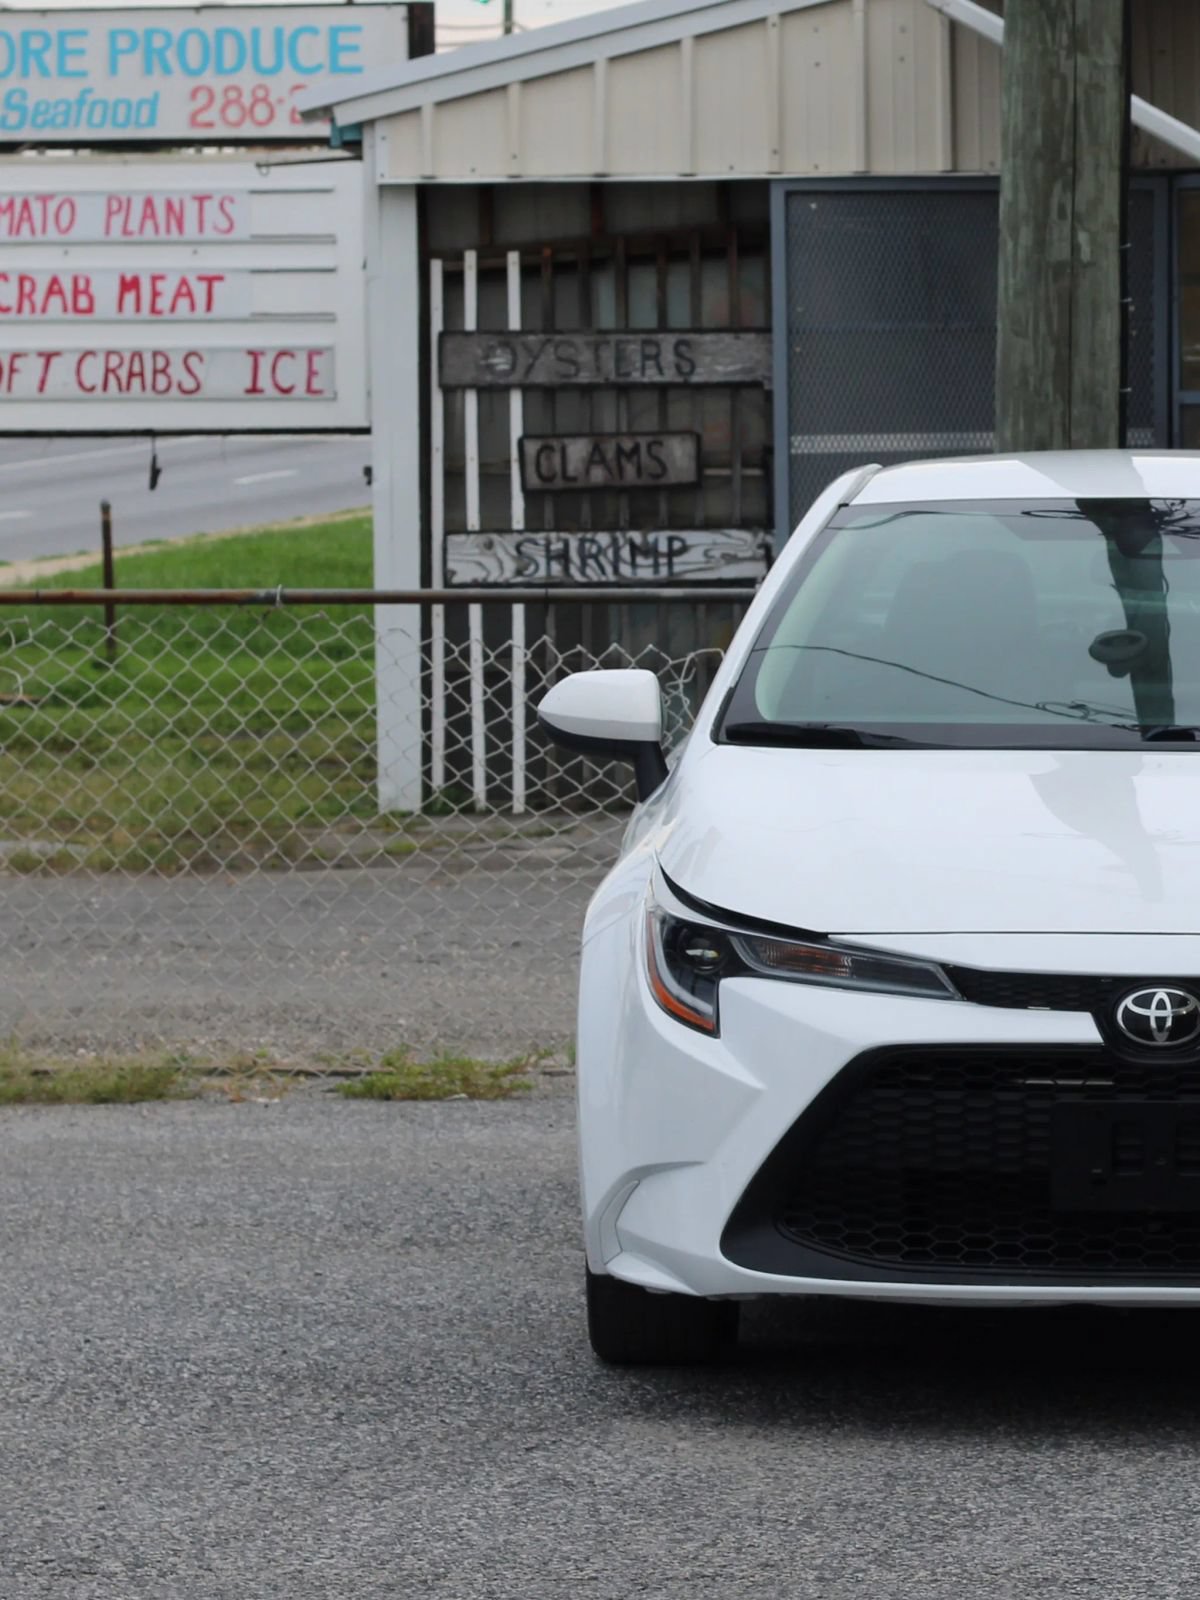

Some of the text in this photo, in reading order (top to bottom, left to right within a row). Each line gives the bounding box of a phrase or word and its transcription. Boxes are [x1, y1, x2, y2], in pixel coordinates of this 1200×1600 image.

[107, 24, 365, 77] PRODUCE
[0, 86, 160, 132] Seafood
[104, 193, 235, 237] PLANTS
[0, 272, 225, 317] CRAB MEAT
[0, 349, 324, 396] FT CRABS ICE
[484, 338, 698, 379] OYSTERS
[535, 439, 668, 484] CLAMS
[515, 535, 687, 577] SHRIMP
